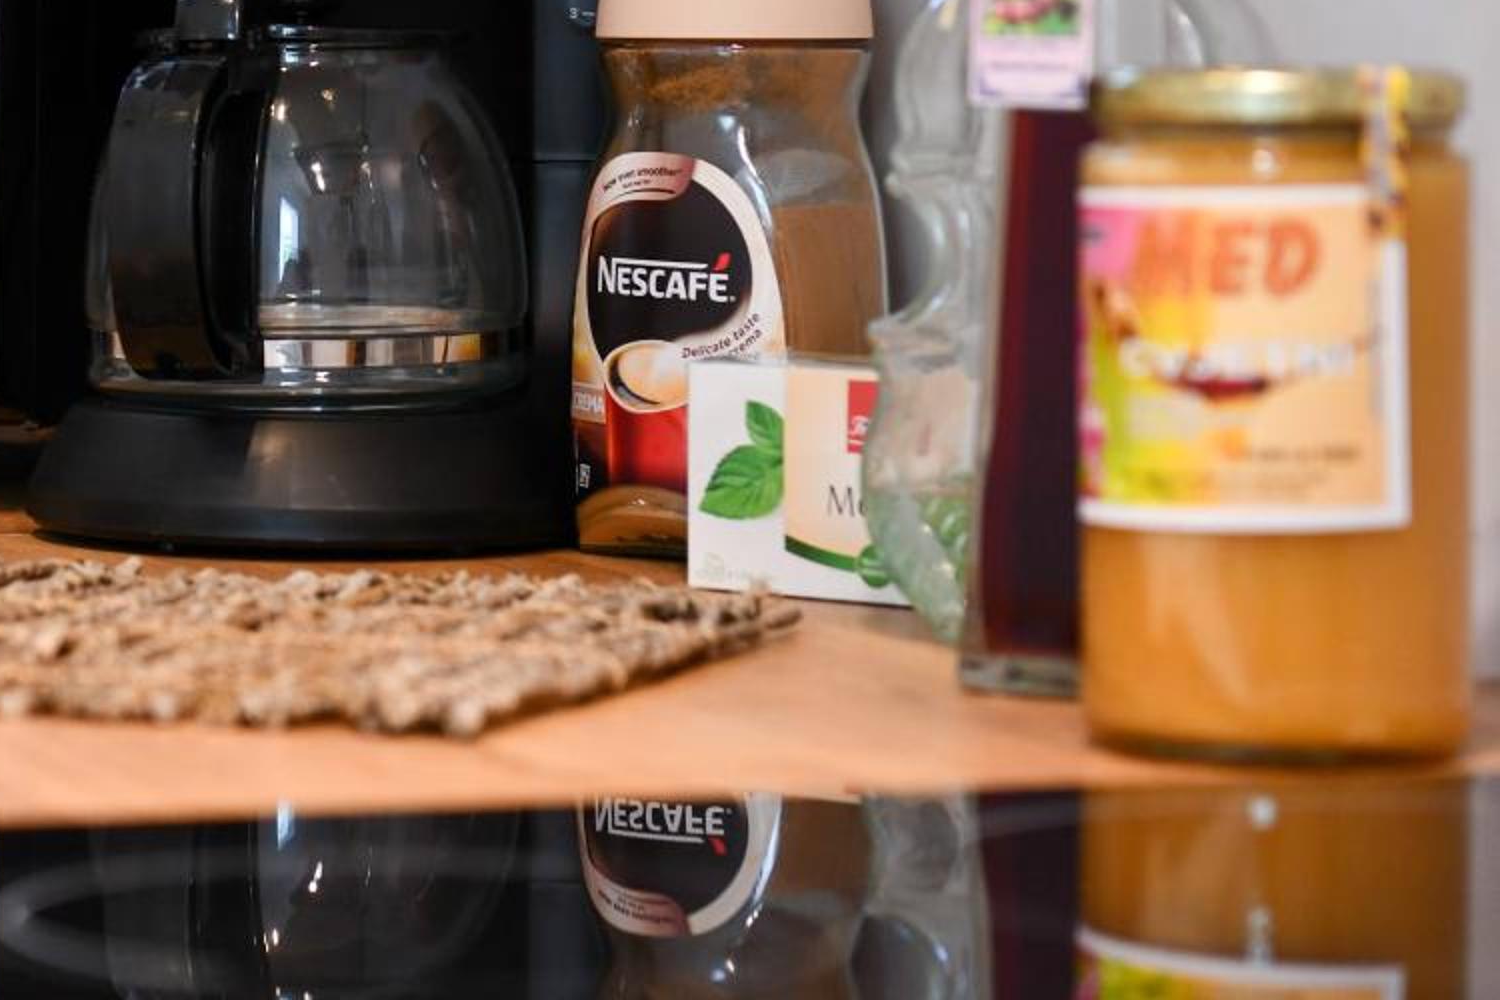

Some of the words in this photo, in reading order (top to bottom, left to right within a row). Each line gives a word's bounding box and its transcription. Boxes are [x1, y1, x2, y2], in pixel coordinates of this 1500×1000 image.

[597, 252, 731, 304] NESCAFÉ
[1134, 217, 1321, 298] MED
[681, 337, 731, 358] Delicate
[732, 313, 760, 341] taste
